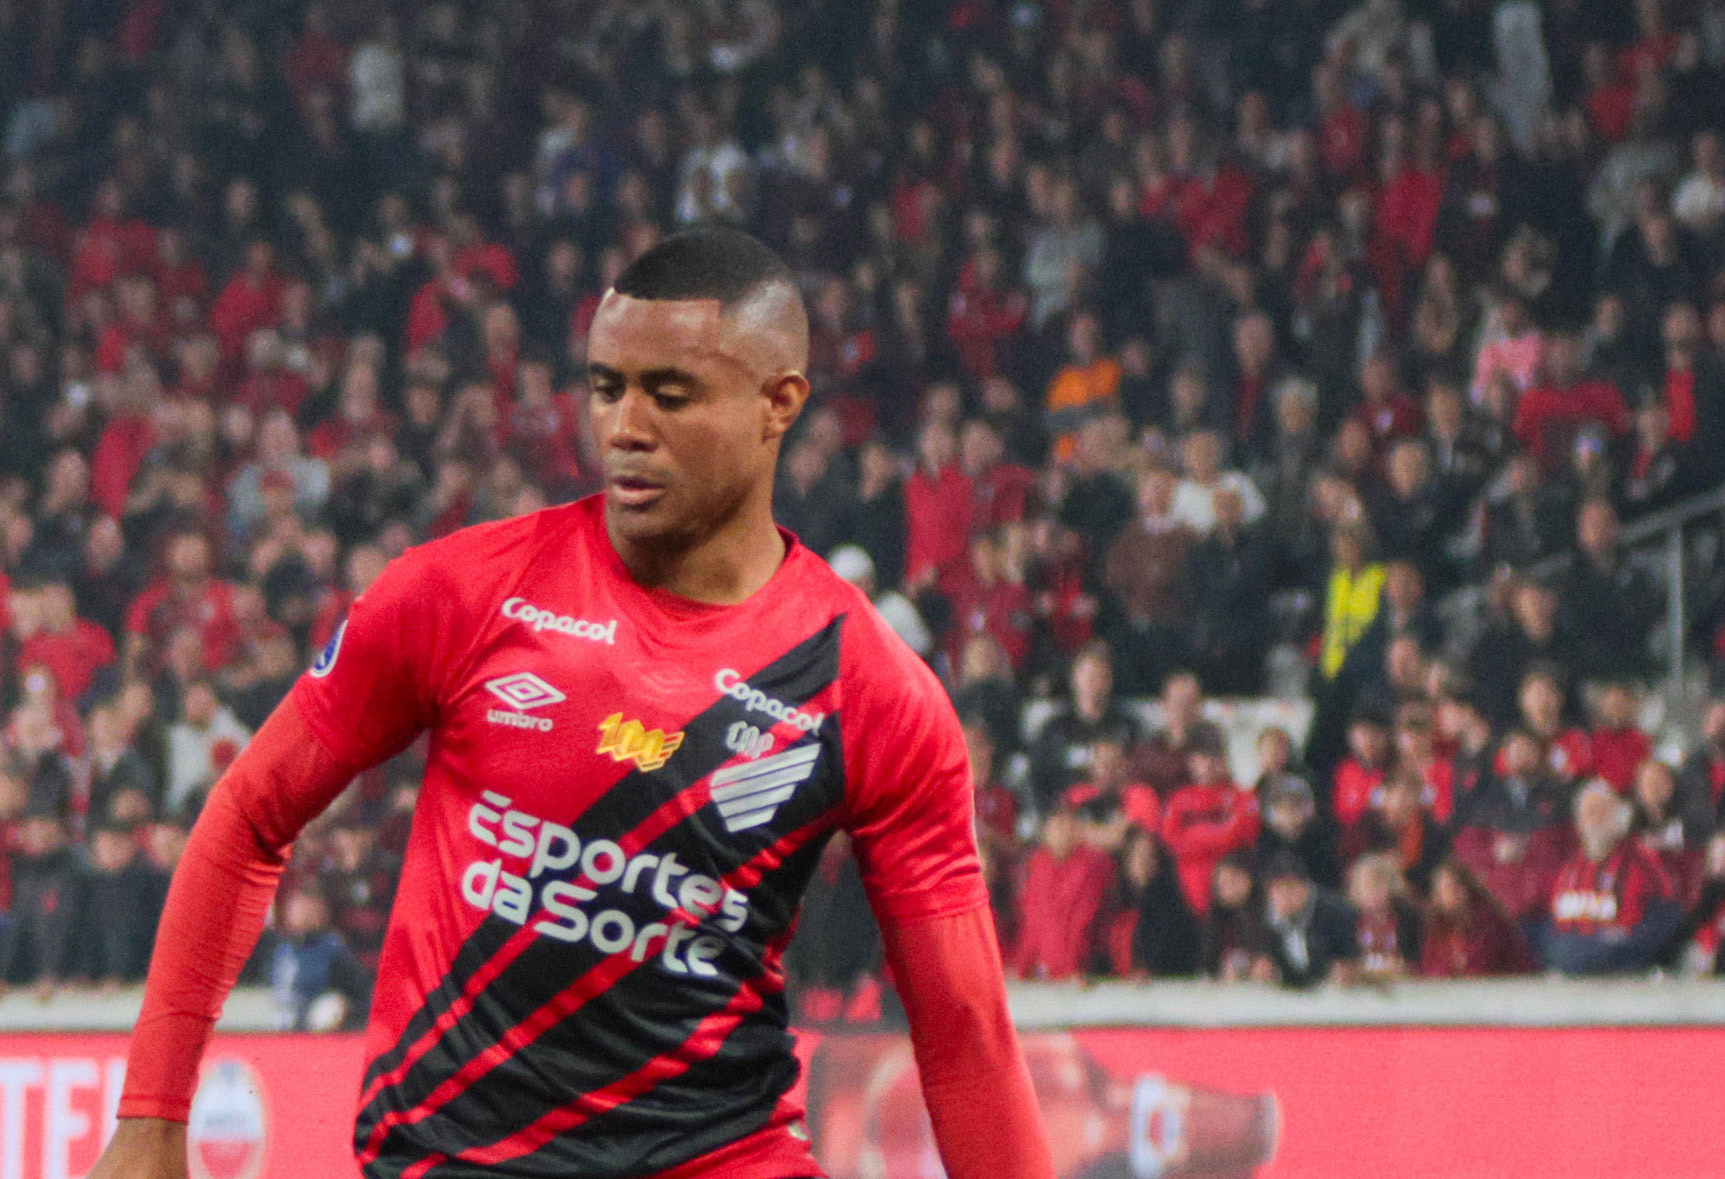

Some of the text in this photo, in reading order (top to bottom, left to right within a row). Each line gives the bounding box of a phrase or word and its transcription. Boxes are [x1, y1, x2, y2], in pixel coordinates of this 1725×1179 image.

[501, 597, 618, 646] Copacol
[486, 709, 555, 733] umbro
[715, 668, 825, 737] Copacol
[468, 789, 749, 933] Esportes
